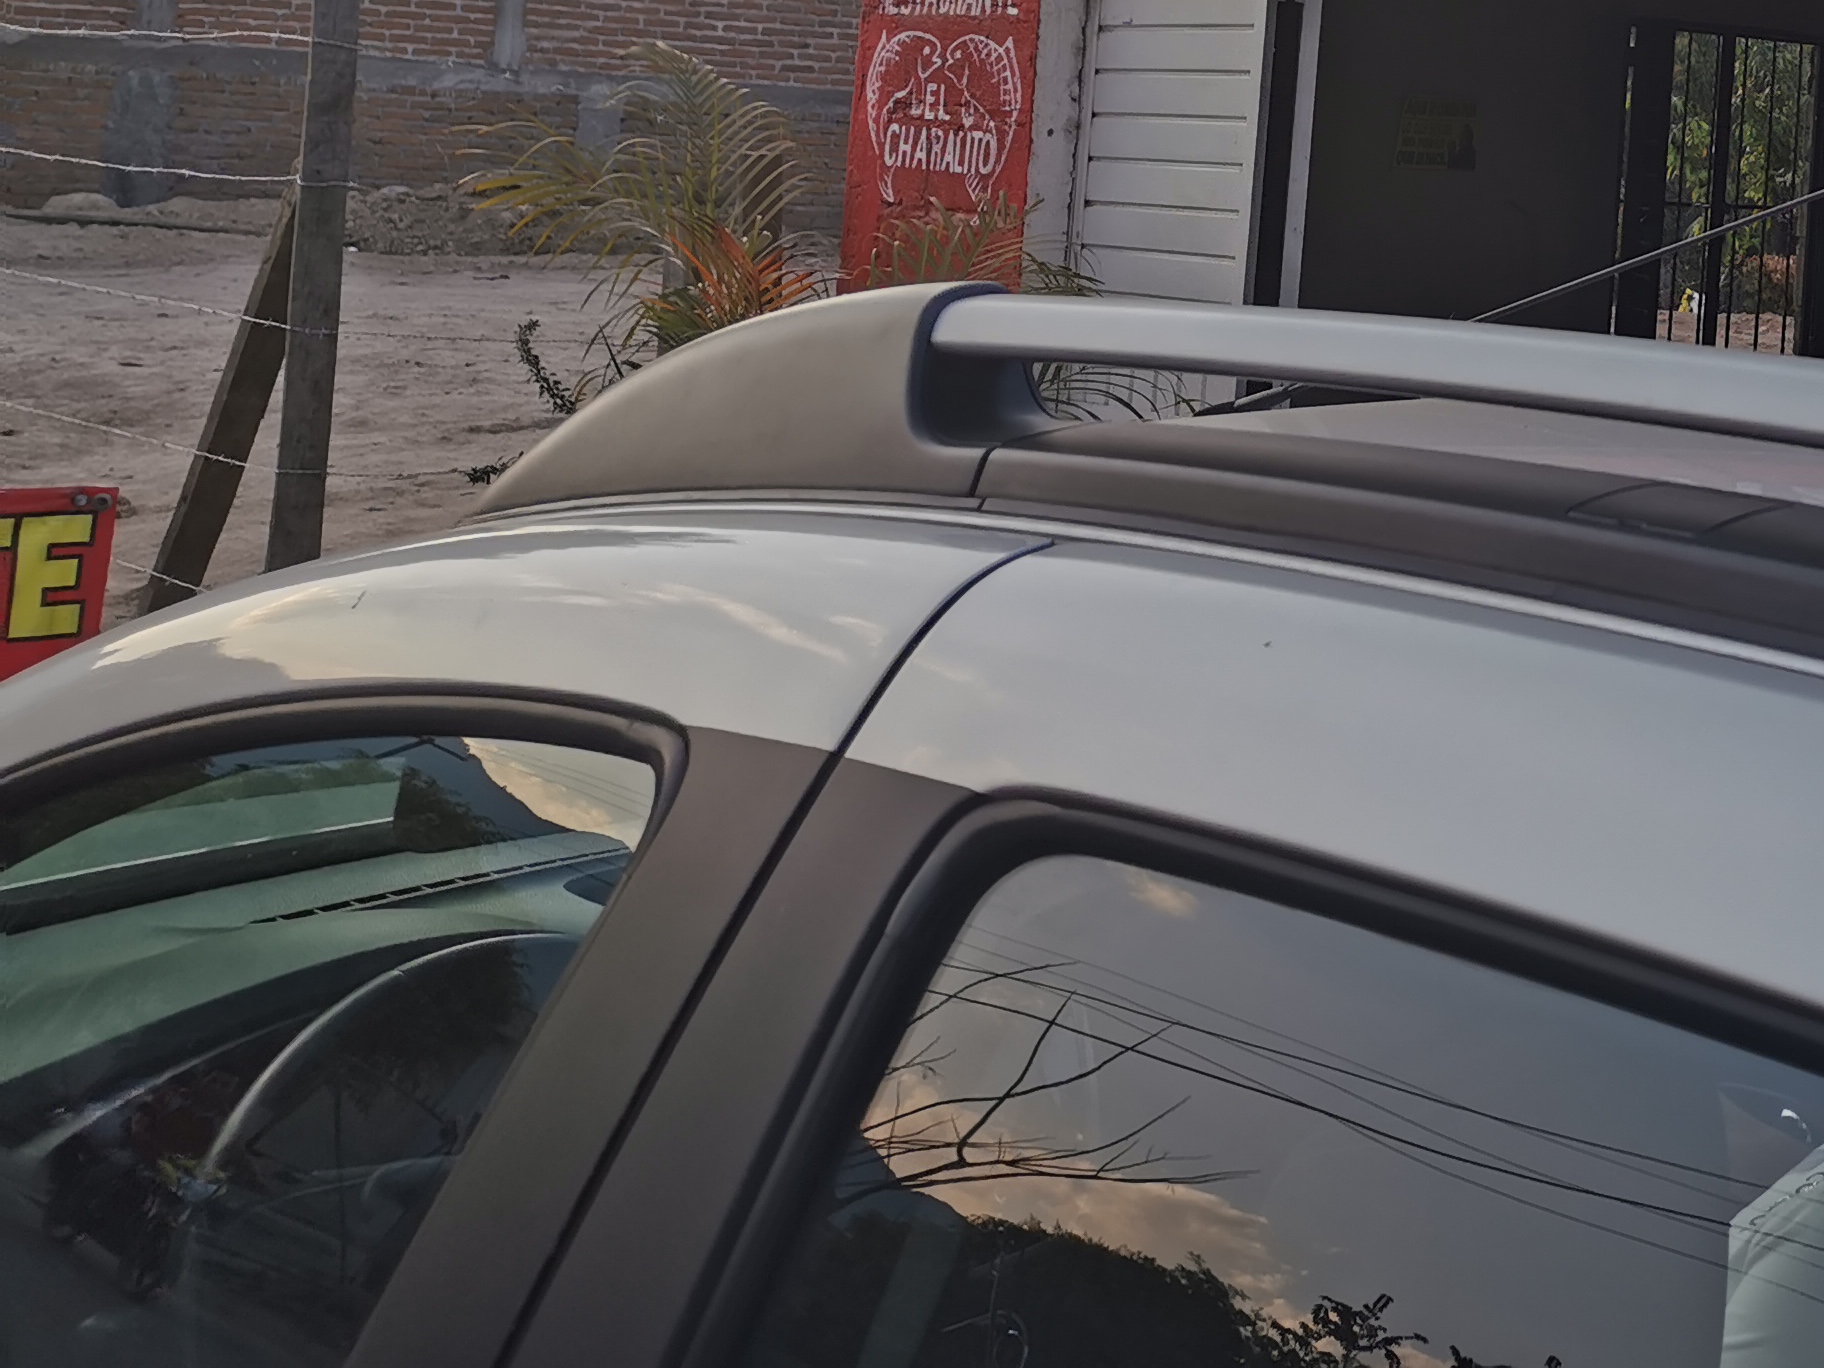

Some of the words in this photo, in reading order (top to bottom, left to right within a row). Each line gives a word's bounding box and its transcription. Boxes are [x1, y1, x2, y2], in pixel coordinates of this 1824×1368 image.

[924, 82, 951, 121] EL
[883, 123, 997, 175] CHARALITO
[0, 510, 98, 643] E
